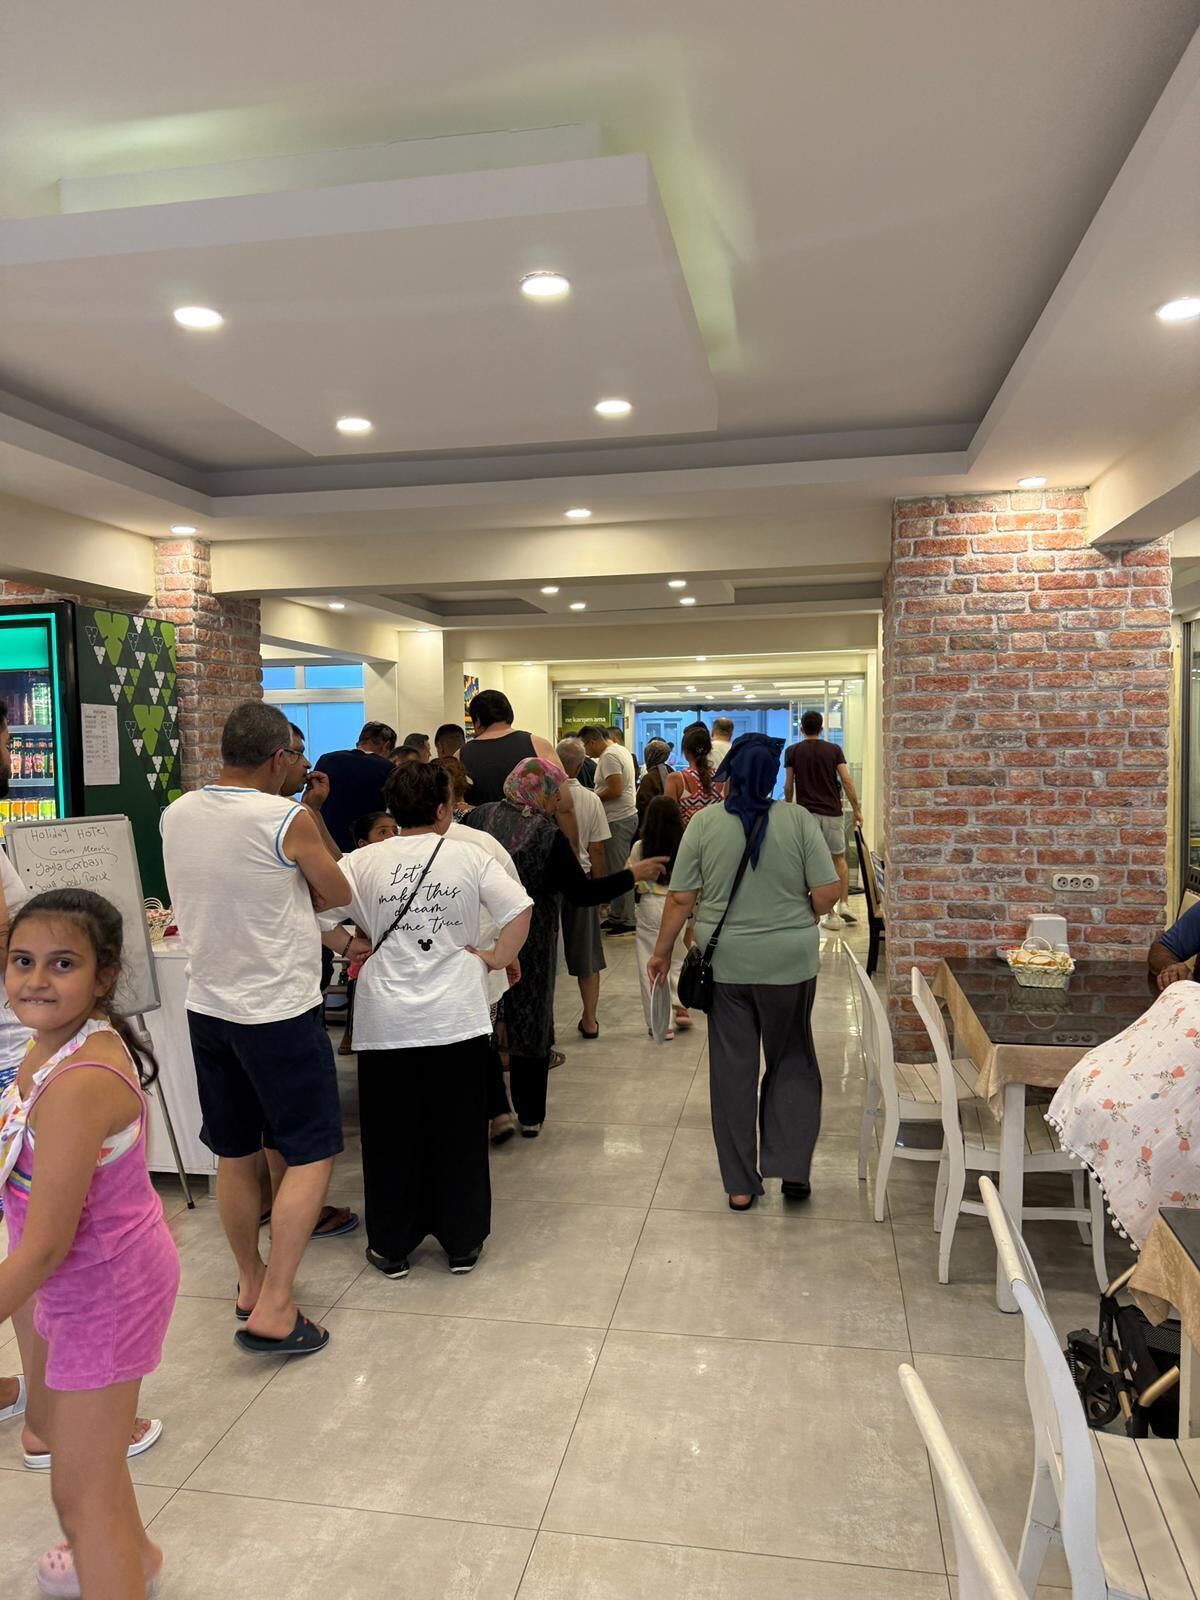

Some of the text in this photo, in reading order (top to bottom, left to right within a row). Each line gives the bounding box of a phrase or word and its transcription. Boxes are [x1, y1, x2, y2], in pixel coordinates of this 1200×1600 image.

[31, 828, 69, 842] Holiday
[422, 882, 461, 902] this
[428, 916, 463, 934] true
